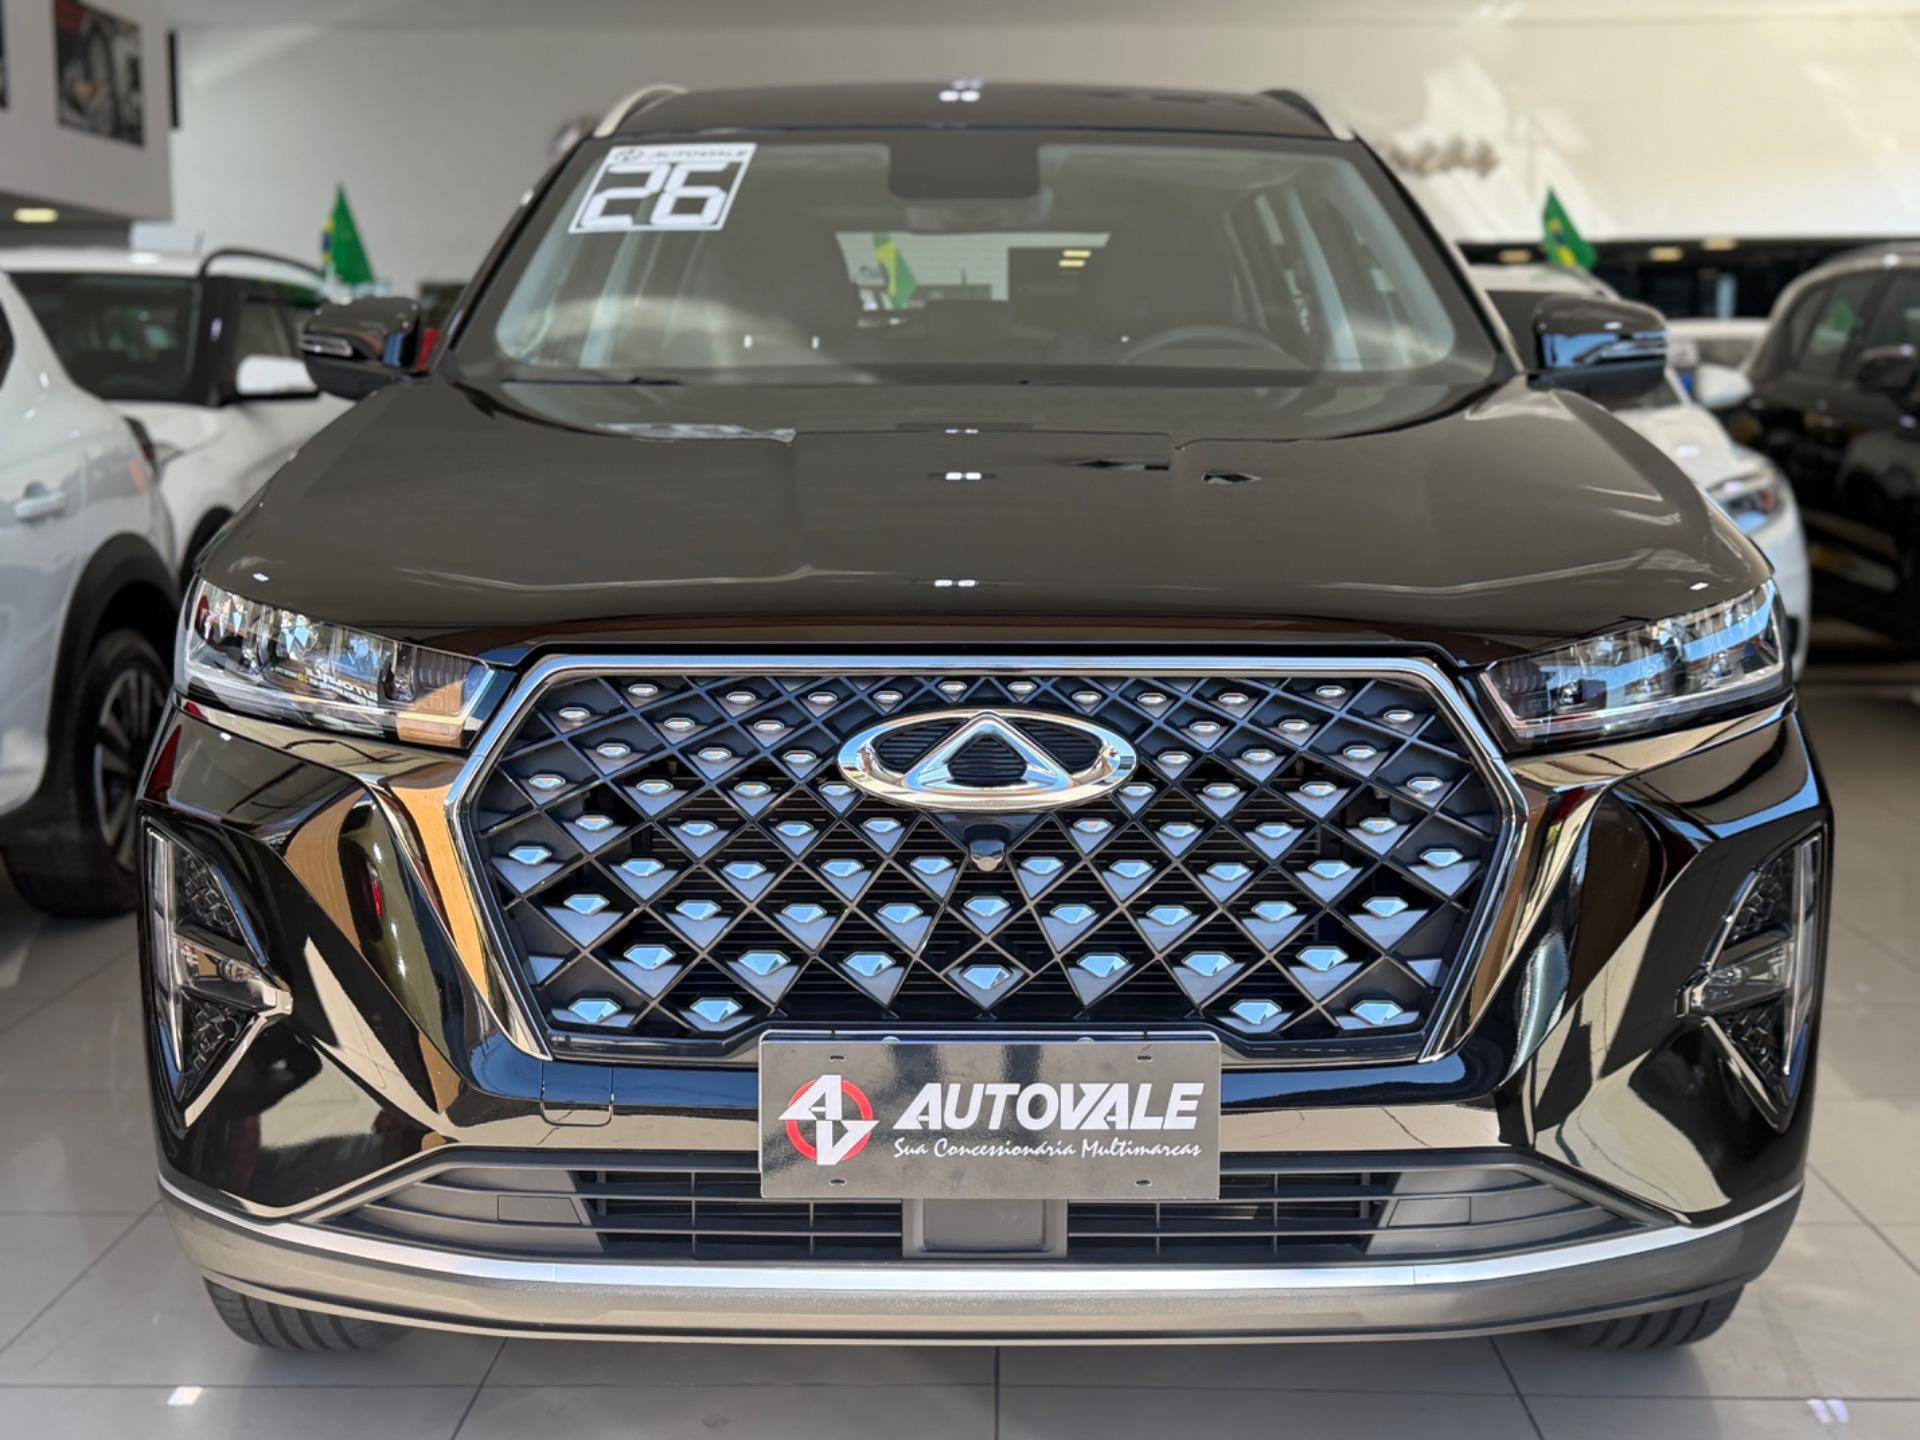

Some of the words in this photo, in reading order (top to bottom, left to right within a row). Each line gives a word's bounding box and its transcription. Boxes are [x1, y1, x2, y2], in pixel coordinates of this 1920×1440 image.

[579, 161, 729, 226] 26
[892, 1083, 1205, 1131] AUTOVALE
[893, 1138, 929, 1158] Sua
[1080, 1137, 1203, 1159] Multimarcas
